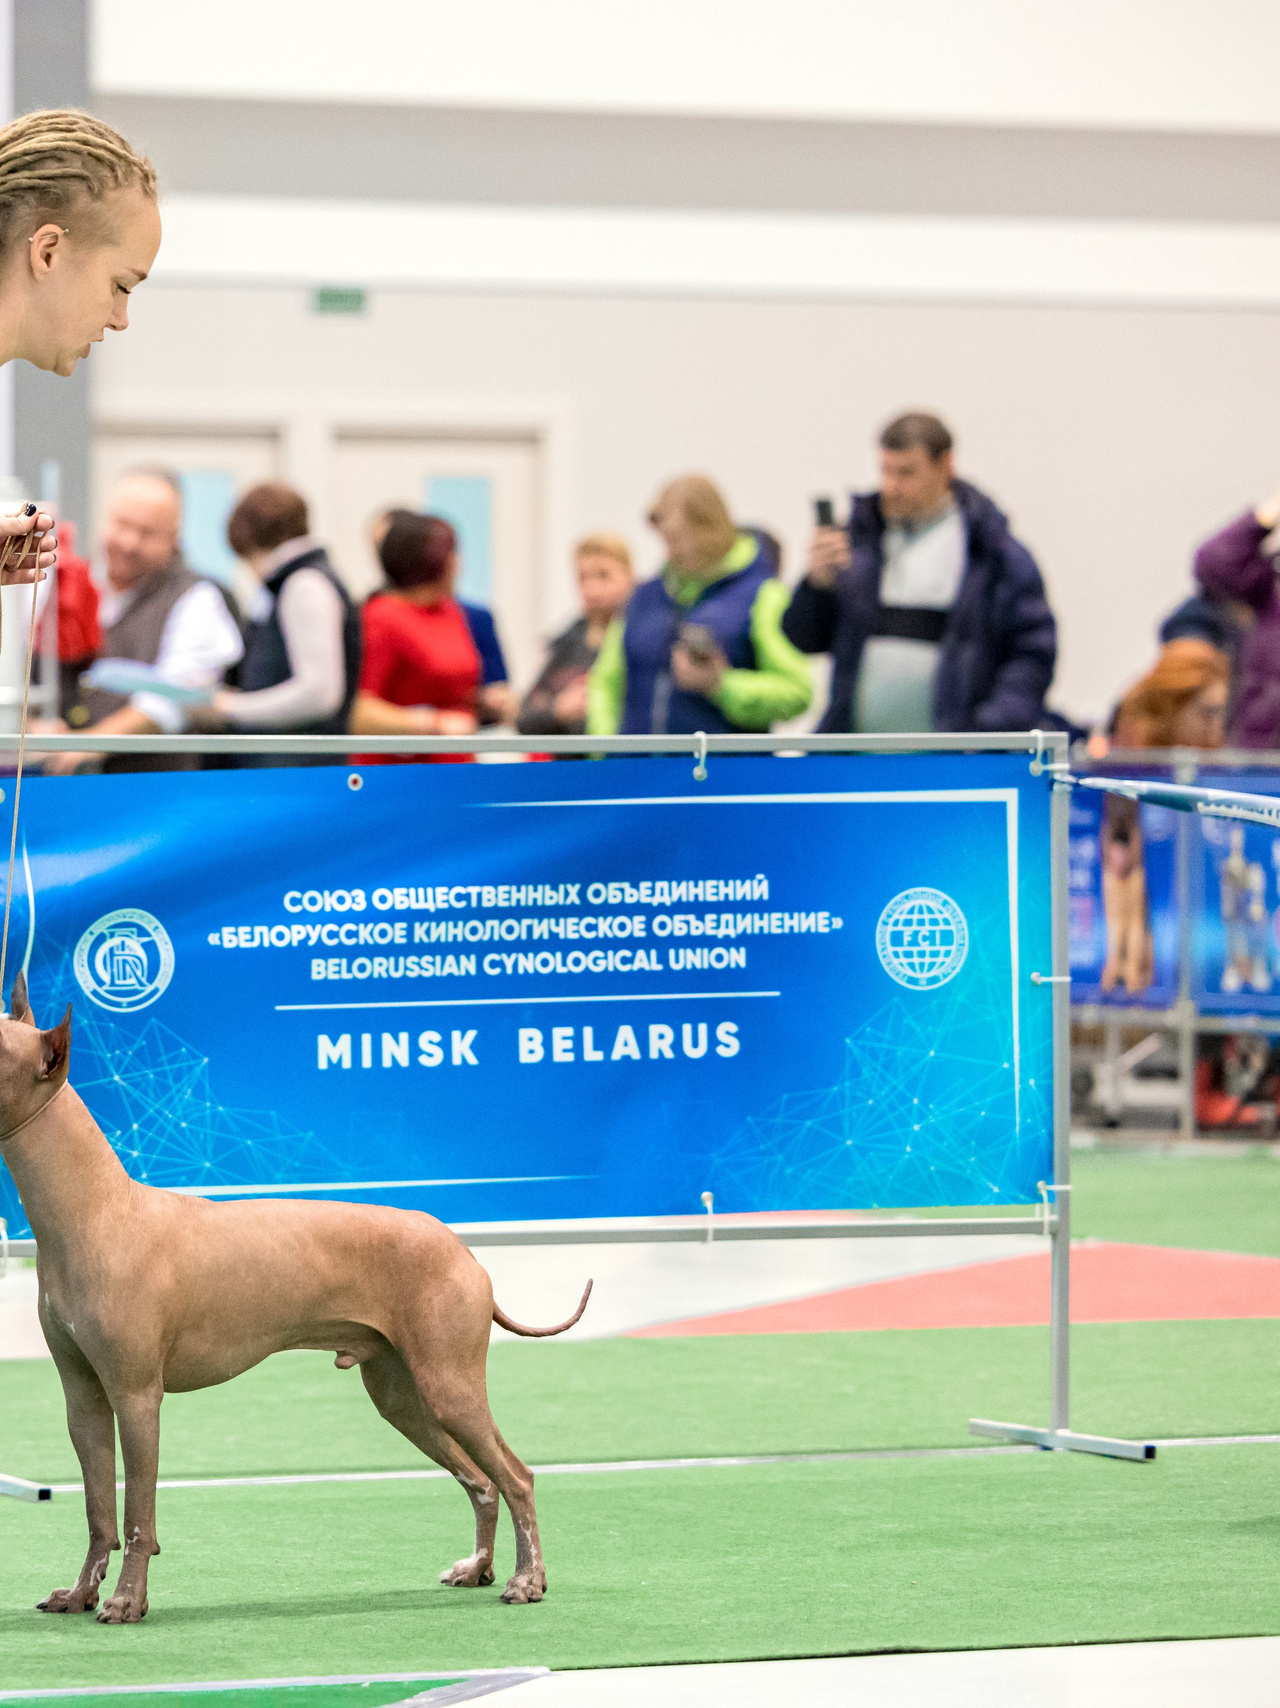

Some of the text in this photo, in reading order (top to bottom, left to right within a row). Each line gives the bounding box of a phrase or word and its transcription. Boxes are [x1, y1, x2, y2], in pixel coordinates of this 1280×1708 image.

[283, 873, 769, 913] СОЮЗ ОБЩЕСТВЕННЫХ ОБЪЕДИНЕНИЙ
[207, 911, 844, 949] «БЕЛОРУССКОЕ КИНОЛОГИЧЕСКОЕ ОБЪЕДИНЕНИЕ»
[903, 929, 941, 947] FCI
[311, 946, 747, 980] BELORUSSIAN CYNOLOGICAL UNION
[317, 1021, 741, 1070] MINSK BELARUS
